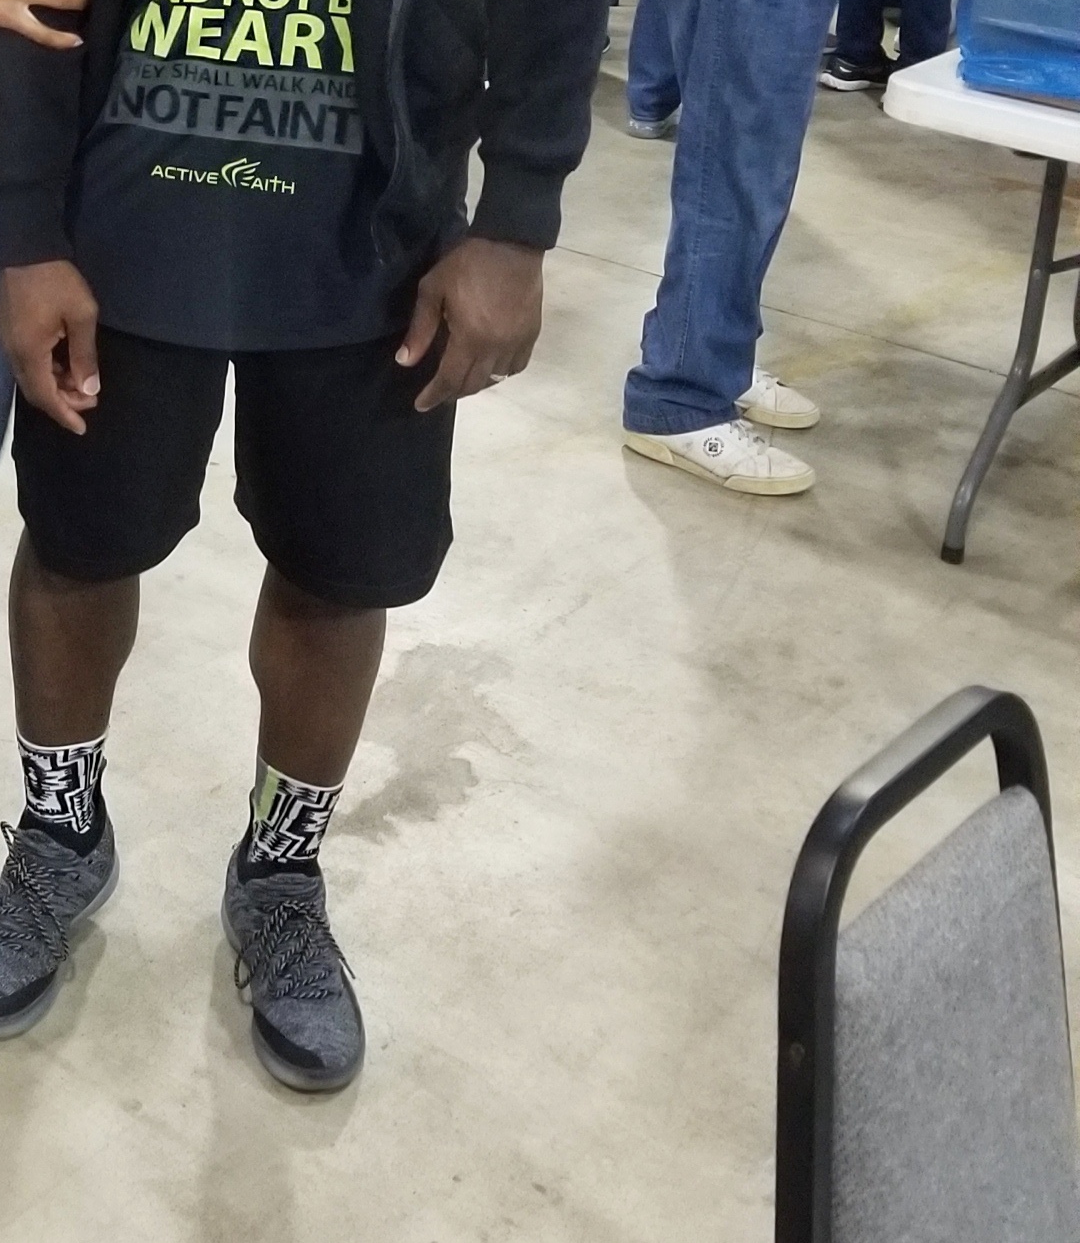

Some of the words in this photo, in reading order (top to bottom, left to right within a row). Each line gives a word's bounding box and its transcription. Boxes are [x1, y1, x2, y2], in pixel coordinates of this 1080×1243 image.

[130, 0, 355, 73] WEARY
[170, 62, 235, 88] SHALL
[242, 71, 306, 94] WALK
[311, 77, 356, 99] AND
[109, 83, 210, 129] NOT
[214, 93, 359, 146] FAINT
[150, 164, 219, 185] ACTIVE
